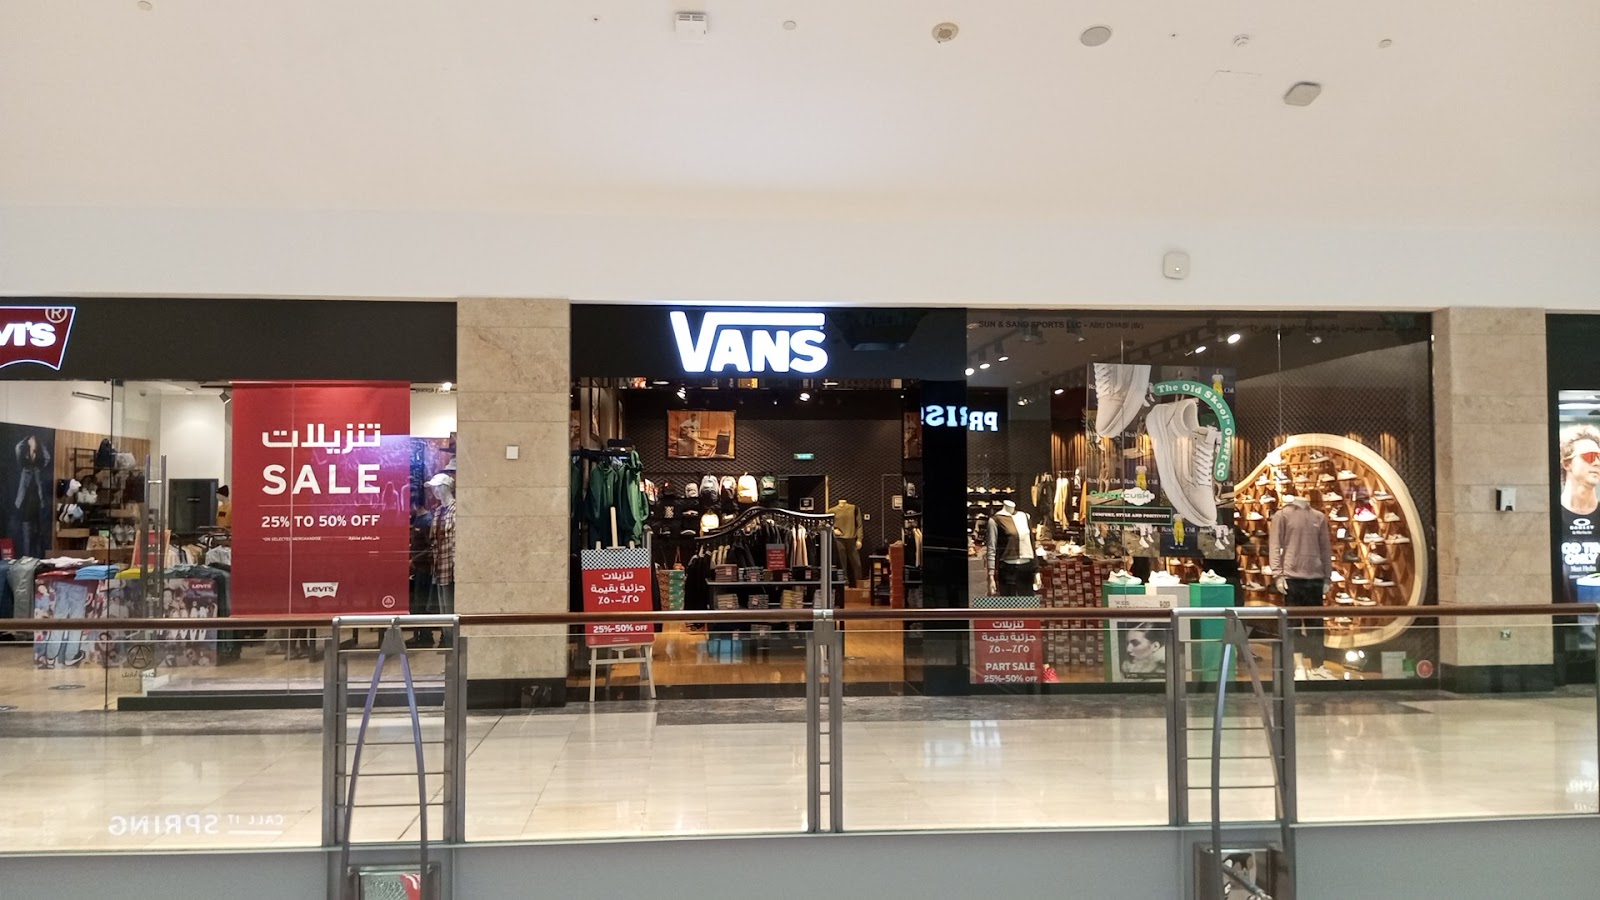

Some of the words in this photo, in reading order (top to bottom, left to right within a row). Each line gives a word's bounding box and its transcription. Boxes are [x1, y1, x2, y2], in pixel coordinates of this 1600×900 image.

[978, 320, 996, 328] SUN
[998, 320, 1004, 328] &
[1006, 320, 1030, 329] SAND
[1031, 320, 1064, 329] SPORTS
[1066, 320, 1082, 329] LLC
[1089, 321, 1106, 329] ABU
[669, 310, 828, 373] VANS
[1157, 383, 1179, 393] The
[1182, 383, 1202, 394] Old
[1216, 461, 1227, 478] CC
[261, 423, 381, 455] تنزيلات
[261, 464, 381, 495] SALE
[261, 515, 290, 528] 25%
[294, 515, 314, 528] TO
[318, 515, 347, 527] 50%
[351, 514, 381, 527] OFF
[601, 571, 634, 581] تنزيلات
[590, 583, 618, 595] بقيمة
[619, 583, 646, 593] جزئية
[593, 624, 634, 634] 25%-50%
[992, 620, 1025, 630] تنزيلات
[982, 632, 1008, 642] بقيمة
[1010, 632, 1036, 642] جزئية
[985, 662, 1011, 671] PART
[1012, 662, 1036, 671] SALE
[983, 674, 1024, 683] 25%-50%
